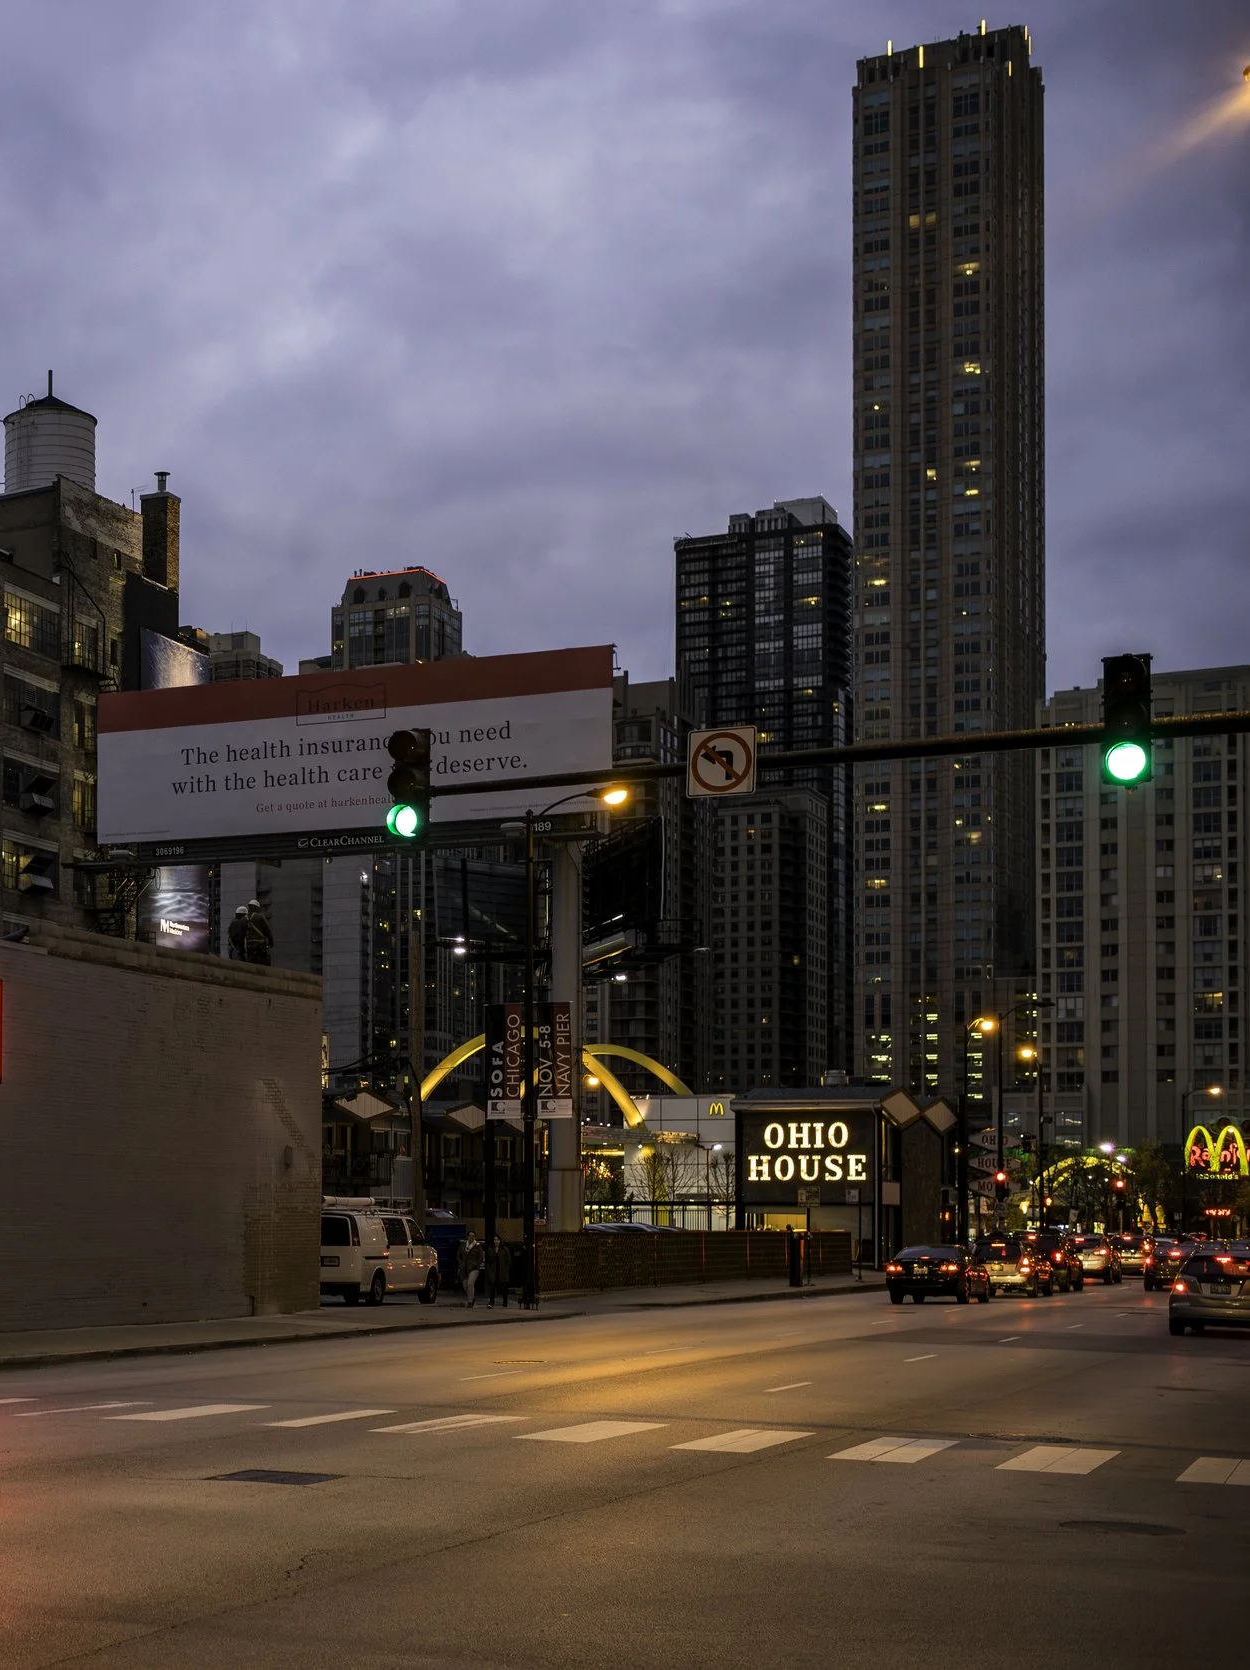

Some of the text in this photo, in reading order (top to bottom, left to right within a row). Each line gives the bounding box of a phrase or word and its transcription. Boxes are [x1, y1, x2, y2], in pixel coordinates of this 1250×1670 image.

[308, 697, 375, 712] Harken
[181, 720, 512, 766] The health insuranc ou need
[172, 774, 217, 795] with
[224, 772, 256, 791] the
[263, 765, 330, 788] health
[337, 765, 383, 782] care
[436, 755, 527, 775] deserve.
[256, 802, 274, 813] Get
[277, 804, 283, 812] a
[286, 801, 315, 813] quote
[318, 799, 328, 809] at
[533, 821, 552, 832] 189
[538, 1025, 551, 1048] 5-8
[506, 1014, 520, 1098] CHICAGO
[556, 1012, 570, 1096] NAVY PIER
[490, 1040, 504, 1097] SOFA
[538, 1057, 553, 1097] NOV
[763, 1121, 849, 1149] OHIO
[981, 1134, 1009, 1145] OHO
[747, 1154, 867, 1181] HOUSE
[978, 1158, 1012, 1169] HOUE
